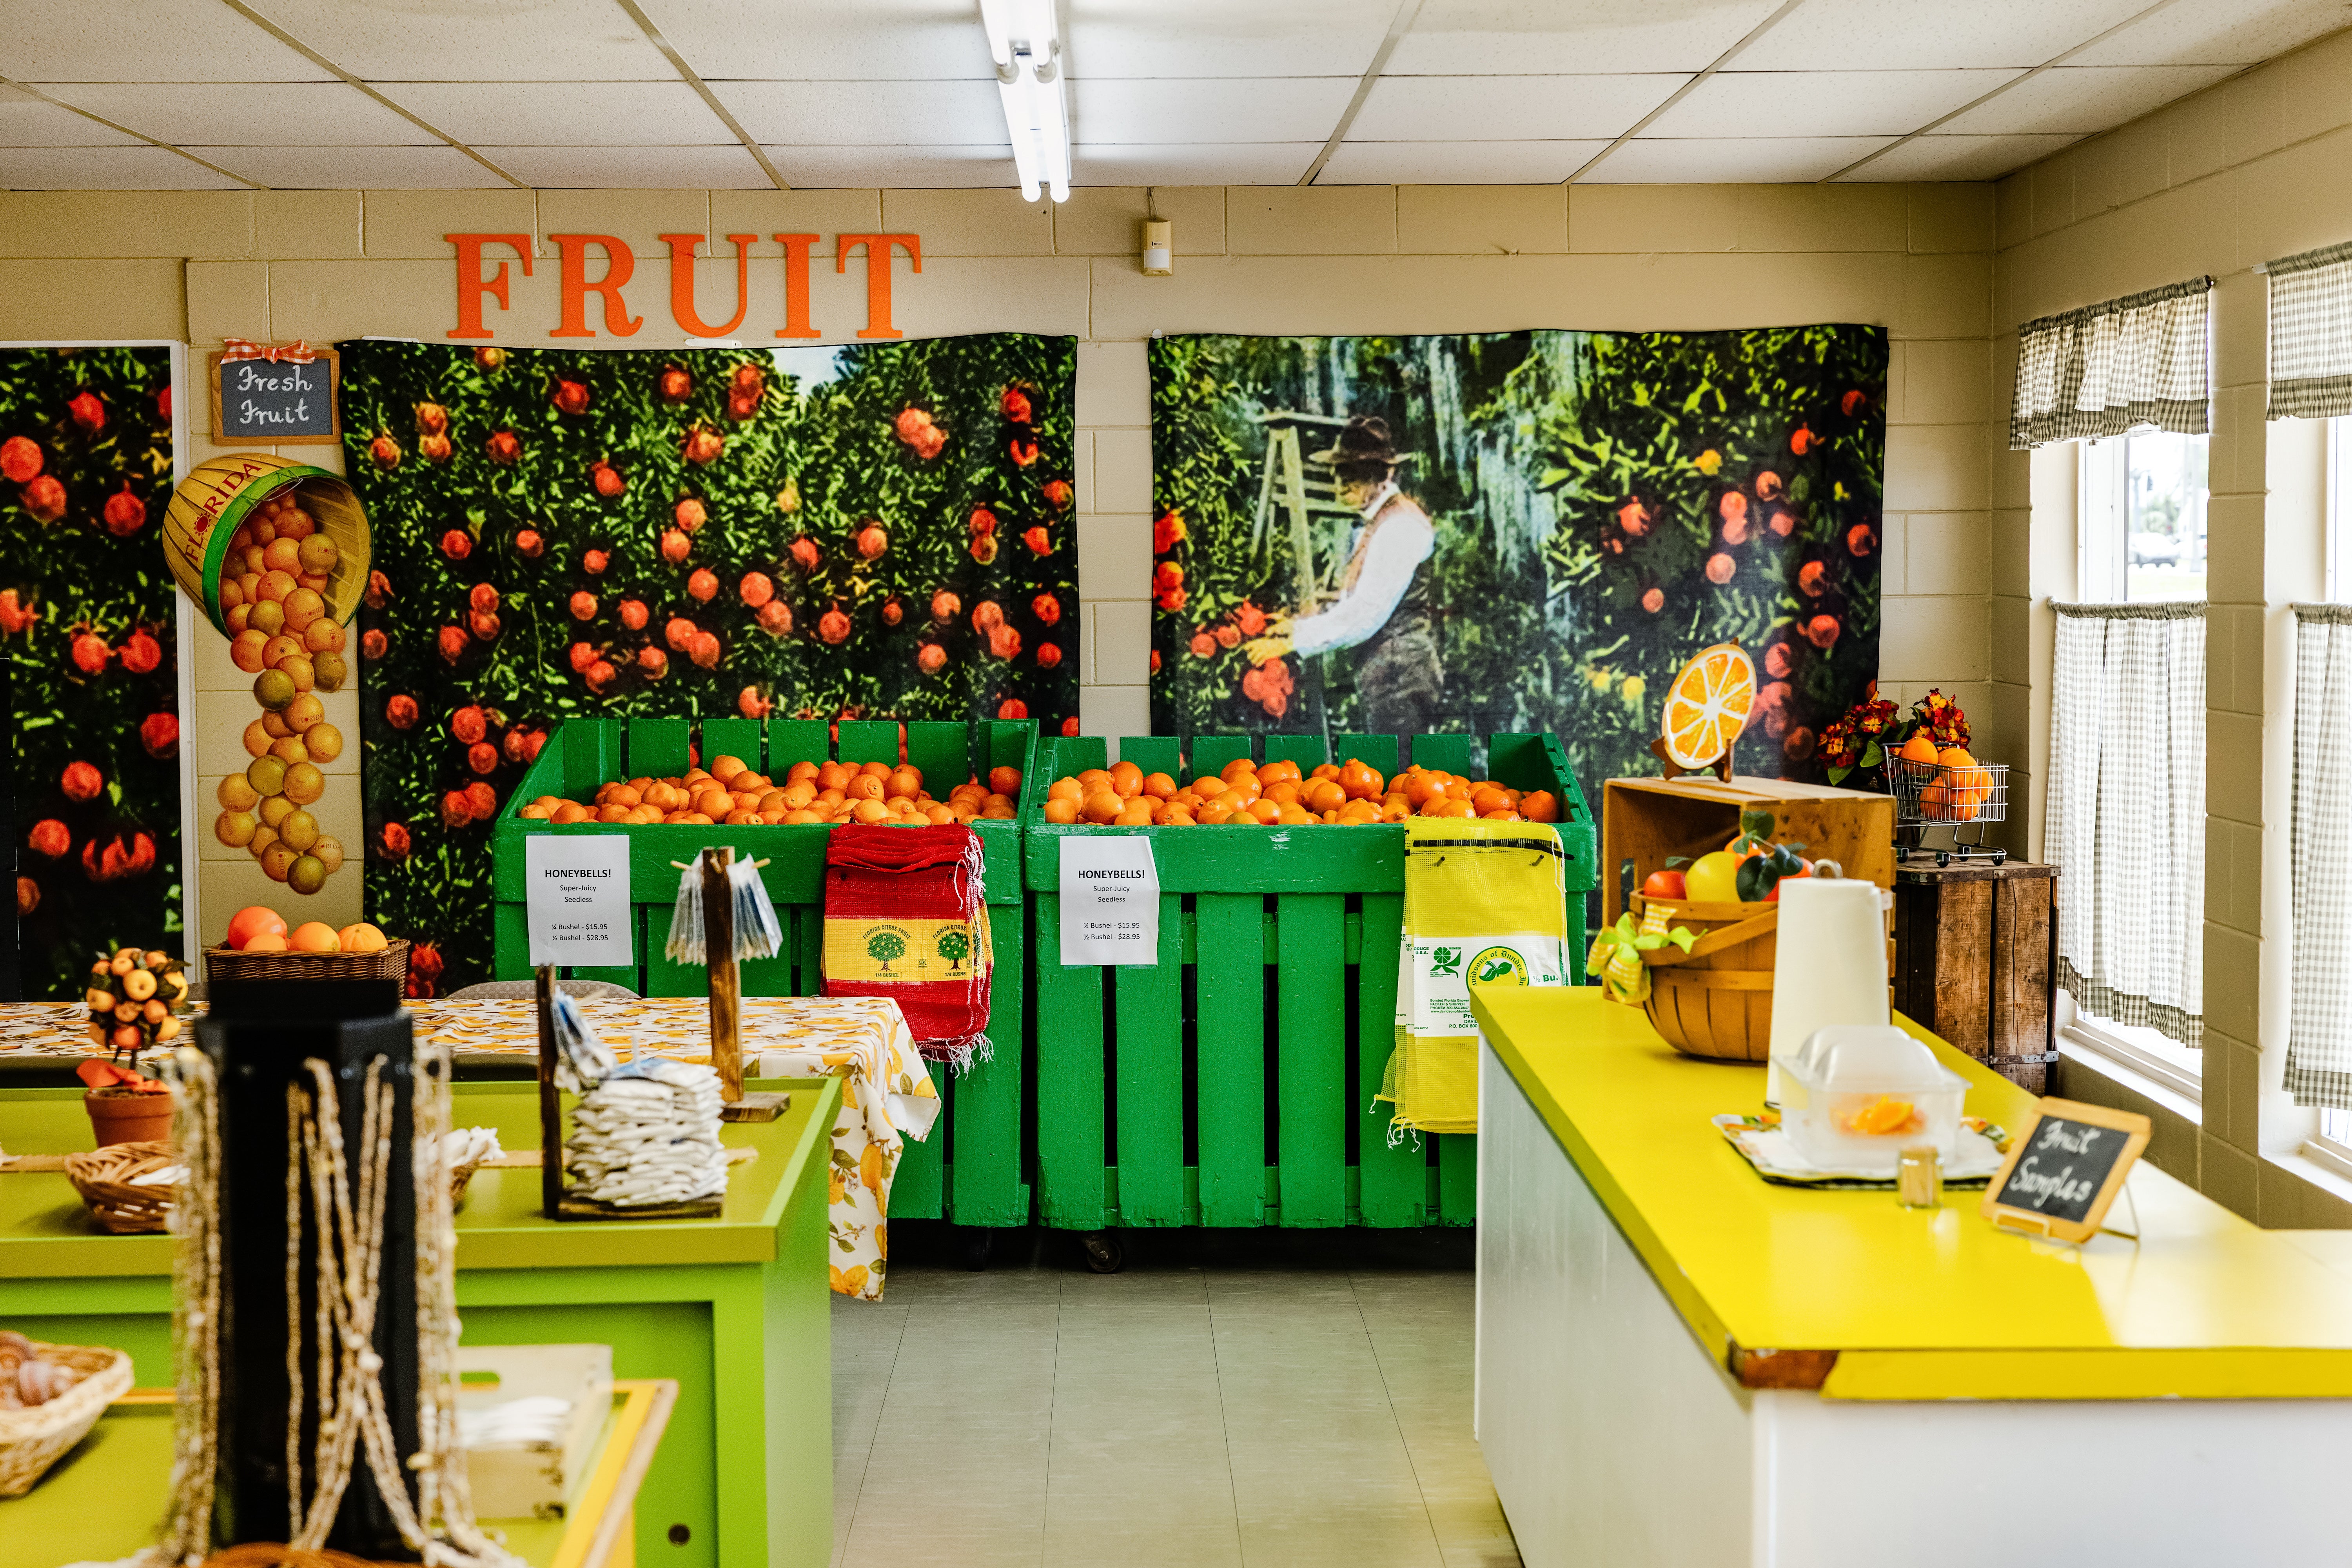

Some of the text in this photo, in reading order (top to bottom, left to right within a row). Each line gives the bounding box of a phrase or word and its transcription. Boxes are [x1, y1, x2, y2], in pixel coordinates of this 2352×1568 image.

[445, 234, 922, 339] FRUIT
[237, 365, 312, 392] Fresh
[240, 398, 310, 425] Fruit
[185, 463, 263, 563] FLORIDA
[545, 869, 611, 878] HONEYBELLS!
[1078, 869, 1145, 878] HONEYBELLS!
[862, 926, 880, 940] FLORIDA
[898, 927, 911, 940] FRUIT
[933, 926, 950, 939] FLORIDA
[1501, 950, 1523, 973] Dundee,
[2038, 1120, 2102, 1155] Fruit
[2009, 1155, 2093, 1208] Samples
